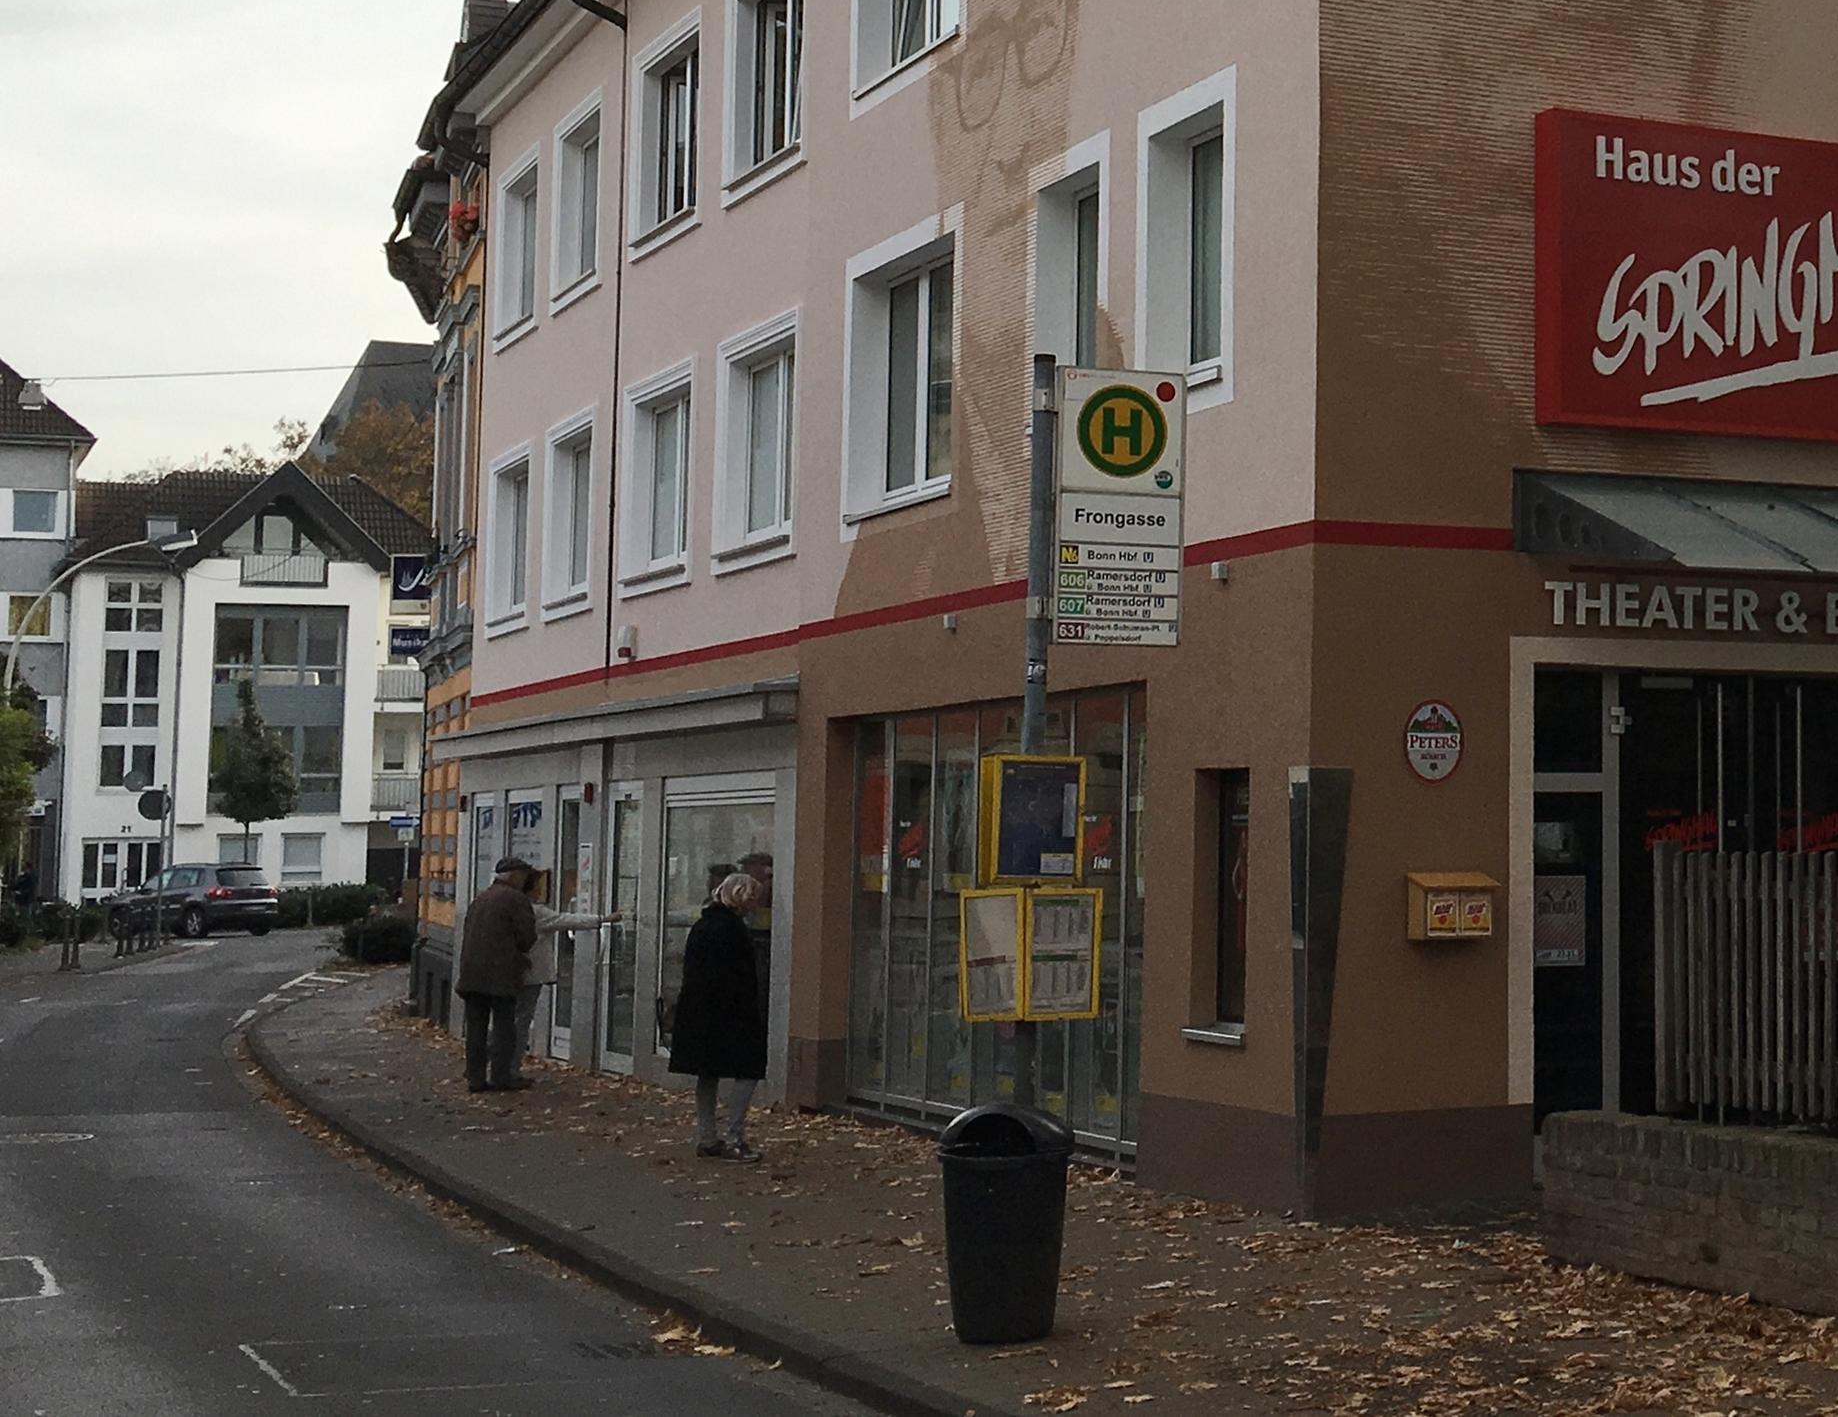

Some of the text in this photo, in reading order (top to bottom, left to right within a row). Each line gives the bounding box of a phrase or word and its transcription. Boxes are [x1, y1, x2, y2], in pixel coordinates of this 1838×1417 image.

[1594, 135, 1781, 196] Haus der
[1102, 407, 1143, 457] H
[1074, 508, 1166, 528] Frongasse
[1087, 550, 1115, 561] Bonn
[1119, 552, 1137, 562] Hbf
[1060, 574, 1085, 587] 606
[1087, 570, 1152, 582] Ramersdorf
[1097, 583, 1120, 591] Bonn
[1059, 599, 1084, 611] 607
[1086, 595, 1150, 607] Ramersdorf
[1544, 581, 1760, 632] THEATER
[1775, 590, 1807, 634] &
[1058, 624, 1084, 637] 631
[1409, 734, 1458, 749] PETERS
